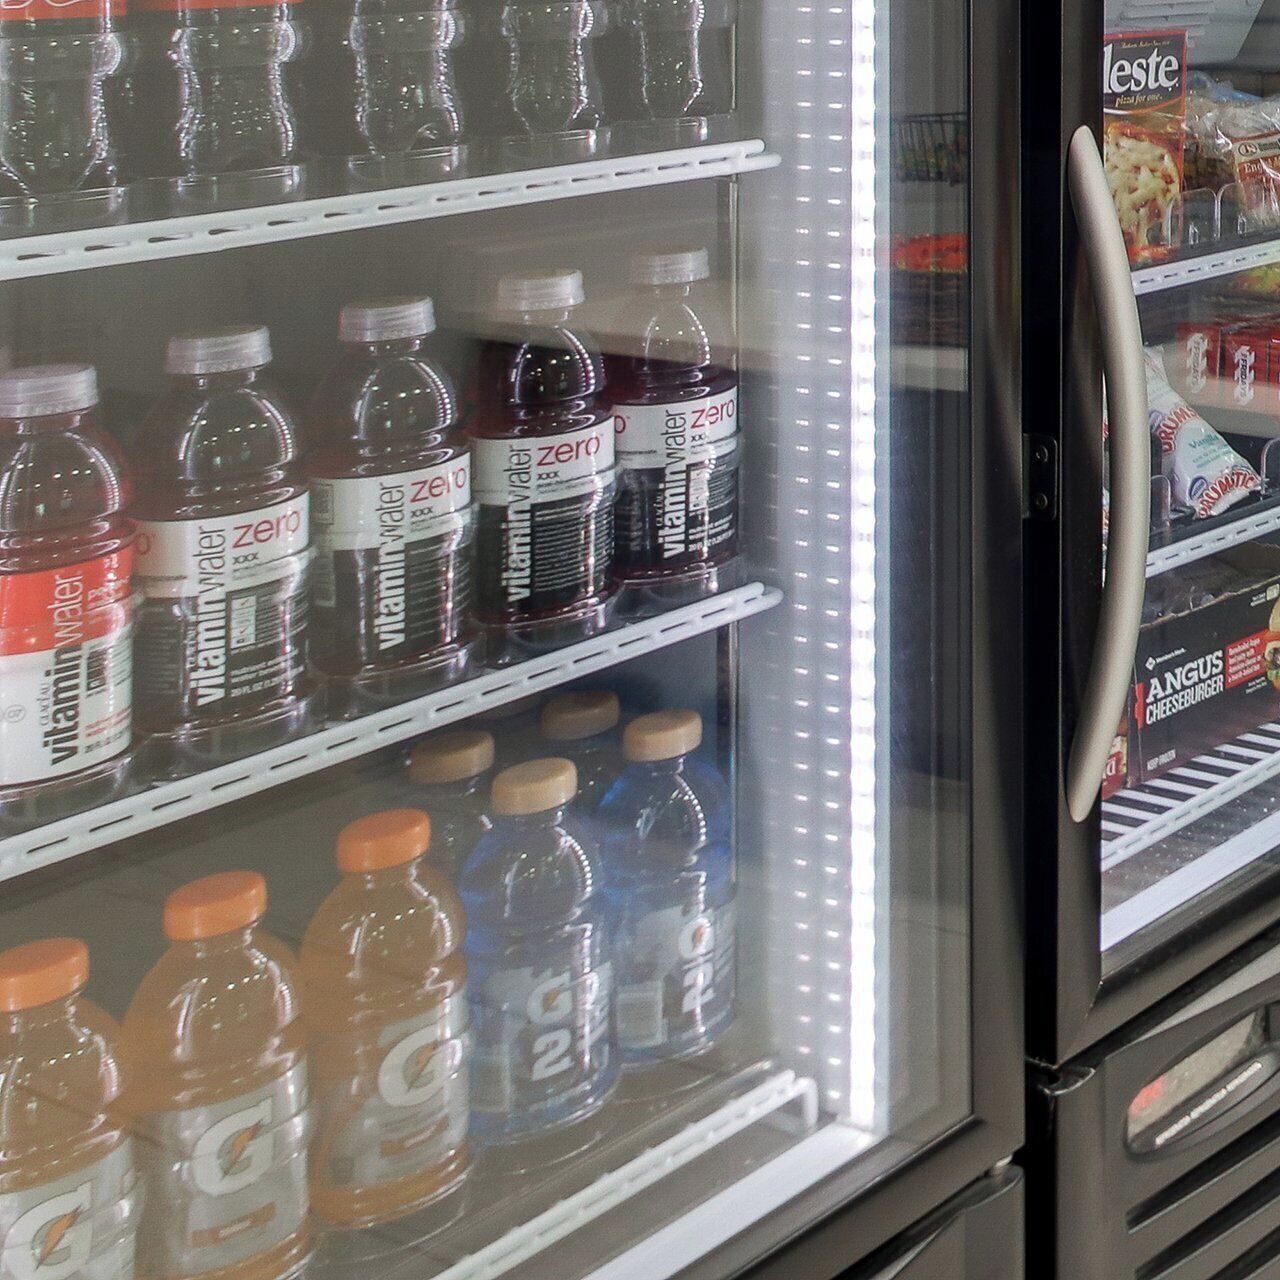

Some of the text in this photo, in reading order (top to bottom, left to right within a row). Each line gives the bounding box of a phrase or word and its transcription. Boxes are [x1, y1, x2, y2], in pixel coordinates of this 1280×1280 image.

[1115, 94, 1134, 107] pizza
[1239, 358, 1249, 402] FRIDAYS
[690, 398, 736, 430] zero
[536, 434, 600, 468] zero
[410, 466, 466, 504] zero
[231, 510, 300, 549] zero
[1146, 650, 1224, 703] ANGUS
[1146, 674, 1225, 725] CHEESEBURGER
[526, 972, 574, 1025] G
[532, 1028, 575, 1082] 2
[192, 1096, 273, 1197] G
